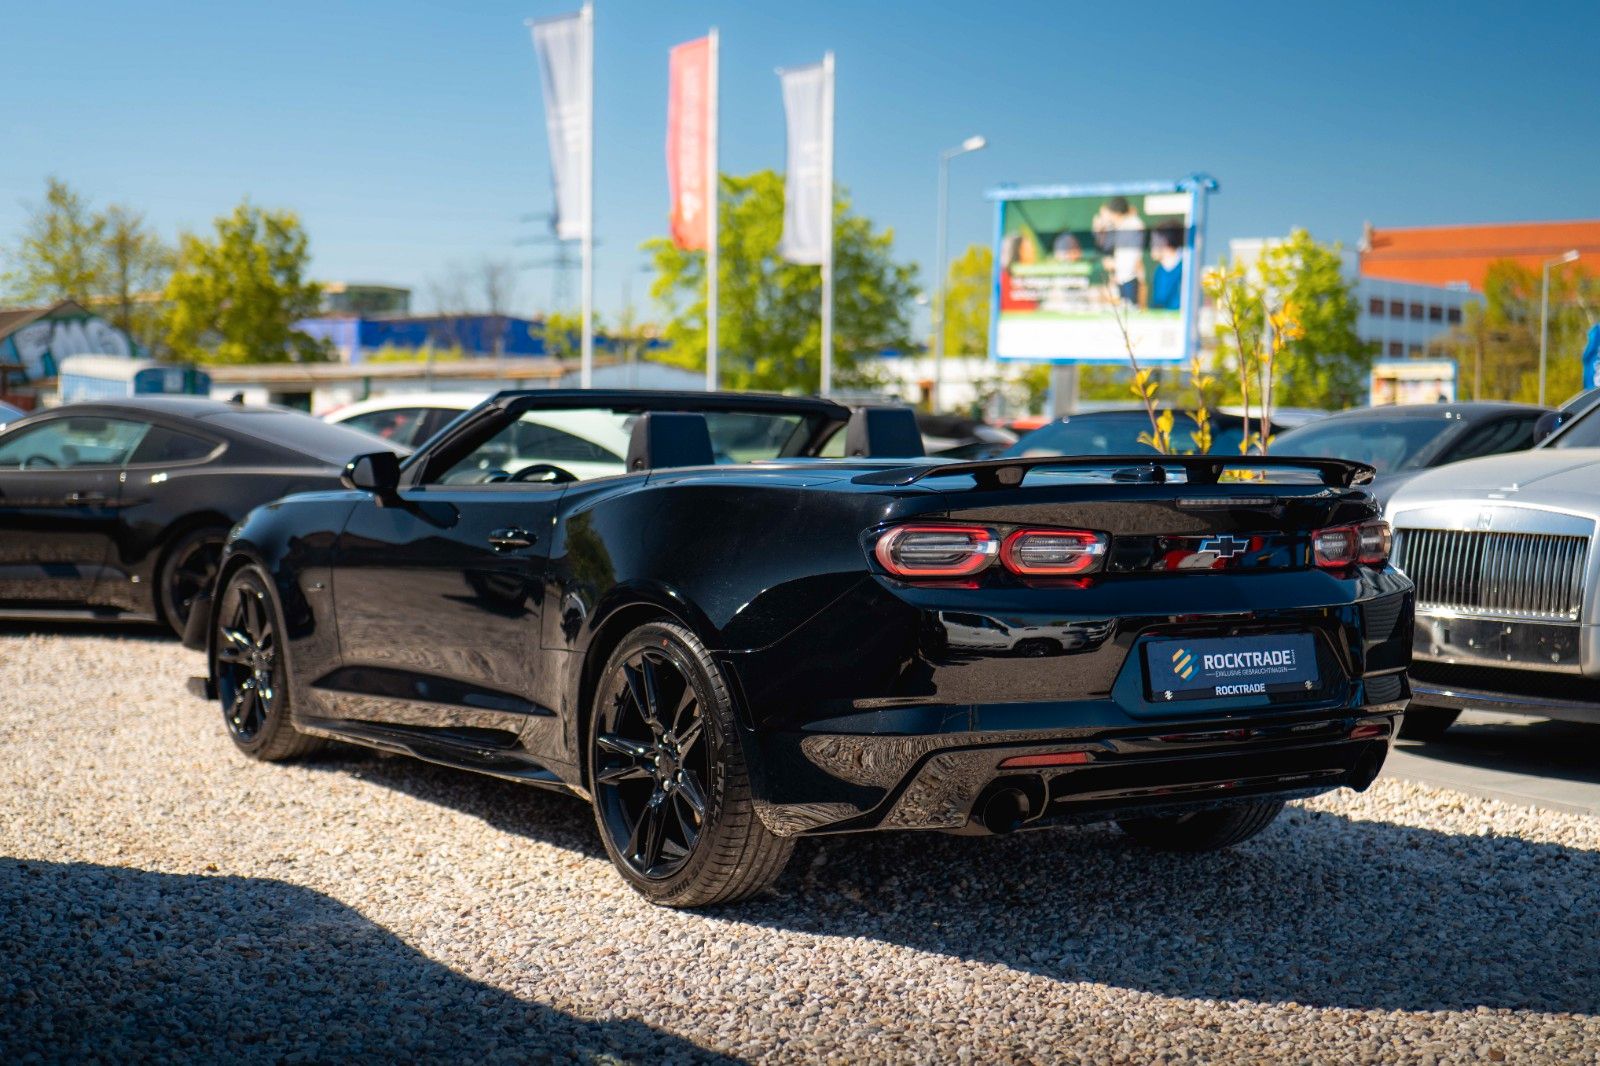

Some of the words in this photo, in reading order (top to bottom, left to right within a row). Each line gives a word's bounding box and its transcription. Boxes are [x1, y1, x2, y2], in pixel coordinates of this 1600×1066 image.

[1203, 650, 1291, 669] ROCKTRADE
[1215, 669, 1242, 677] EXKLUSIVE
[1216, 683, 1265, 695] ROCKTRADE
